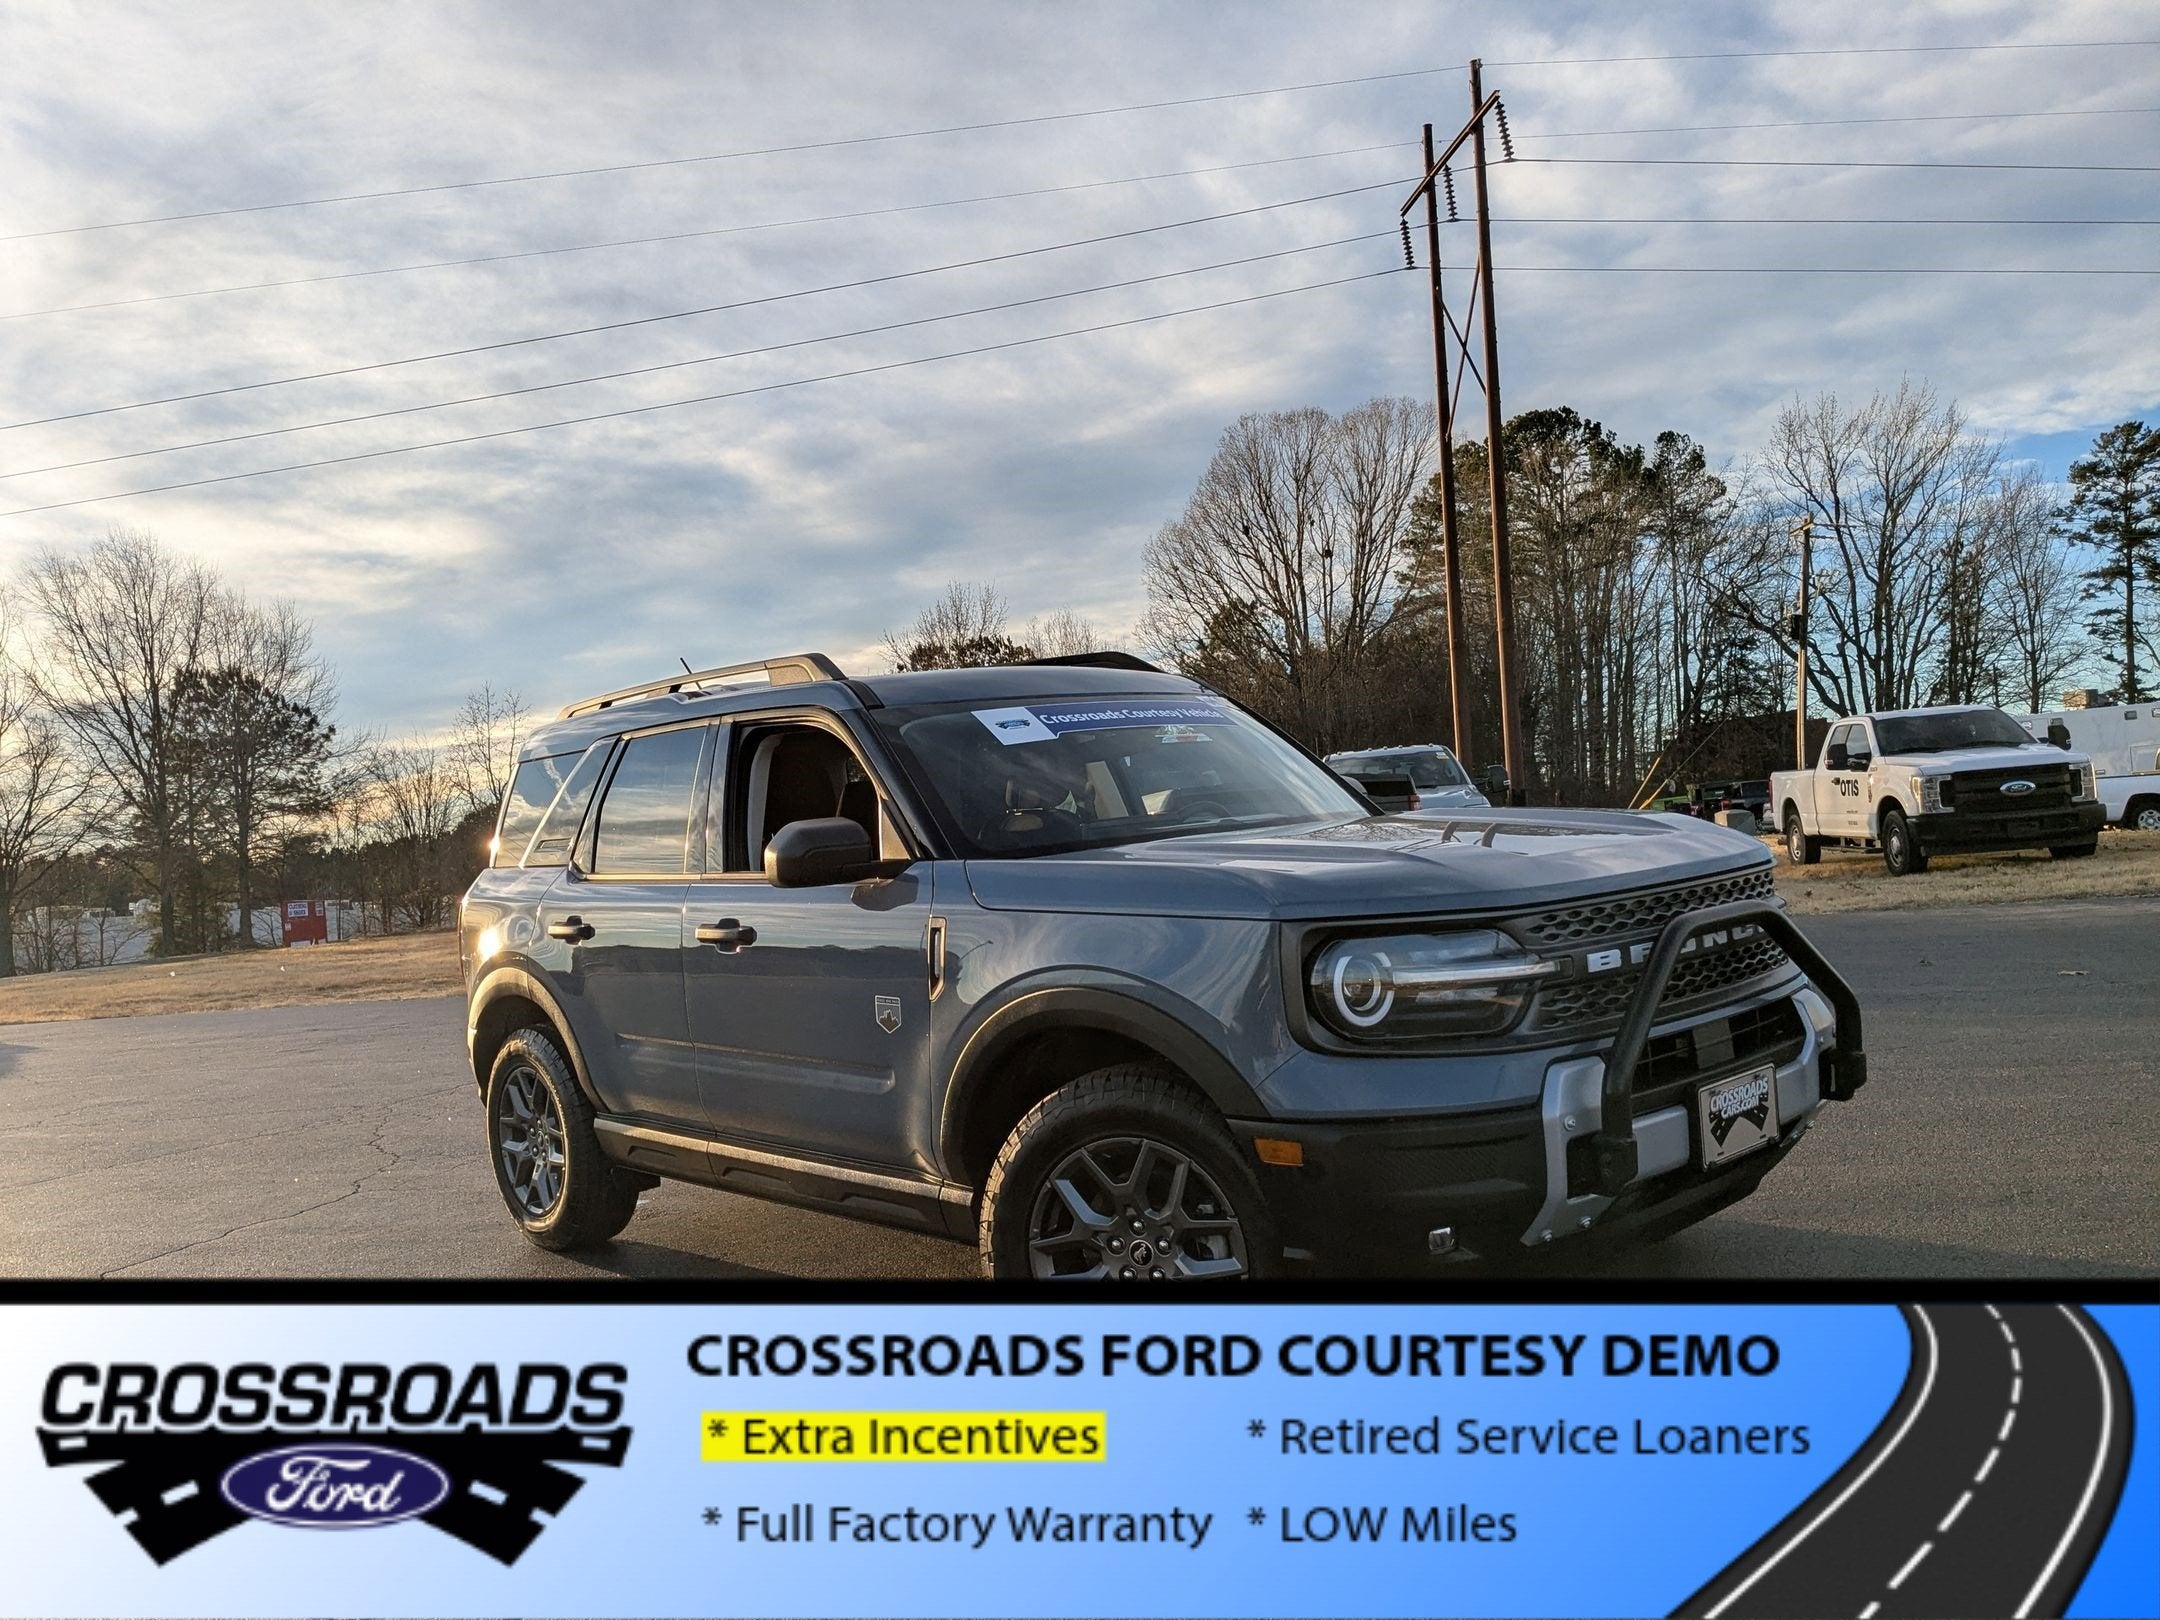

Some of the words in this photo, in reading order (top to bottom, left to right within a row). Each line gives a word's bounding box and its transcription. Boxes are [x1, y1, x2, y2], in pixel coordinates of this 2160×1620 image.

[1039, 708, 1125, 724] Crossroads
[1123, 707, 1182, 720] Courtesy
[1841, 779, 1859, 797] OTIS
[1710, 1077, 1768, 1112] CROSSROADS
[1721, 1095, 1760, 1119] CARS.COM
